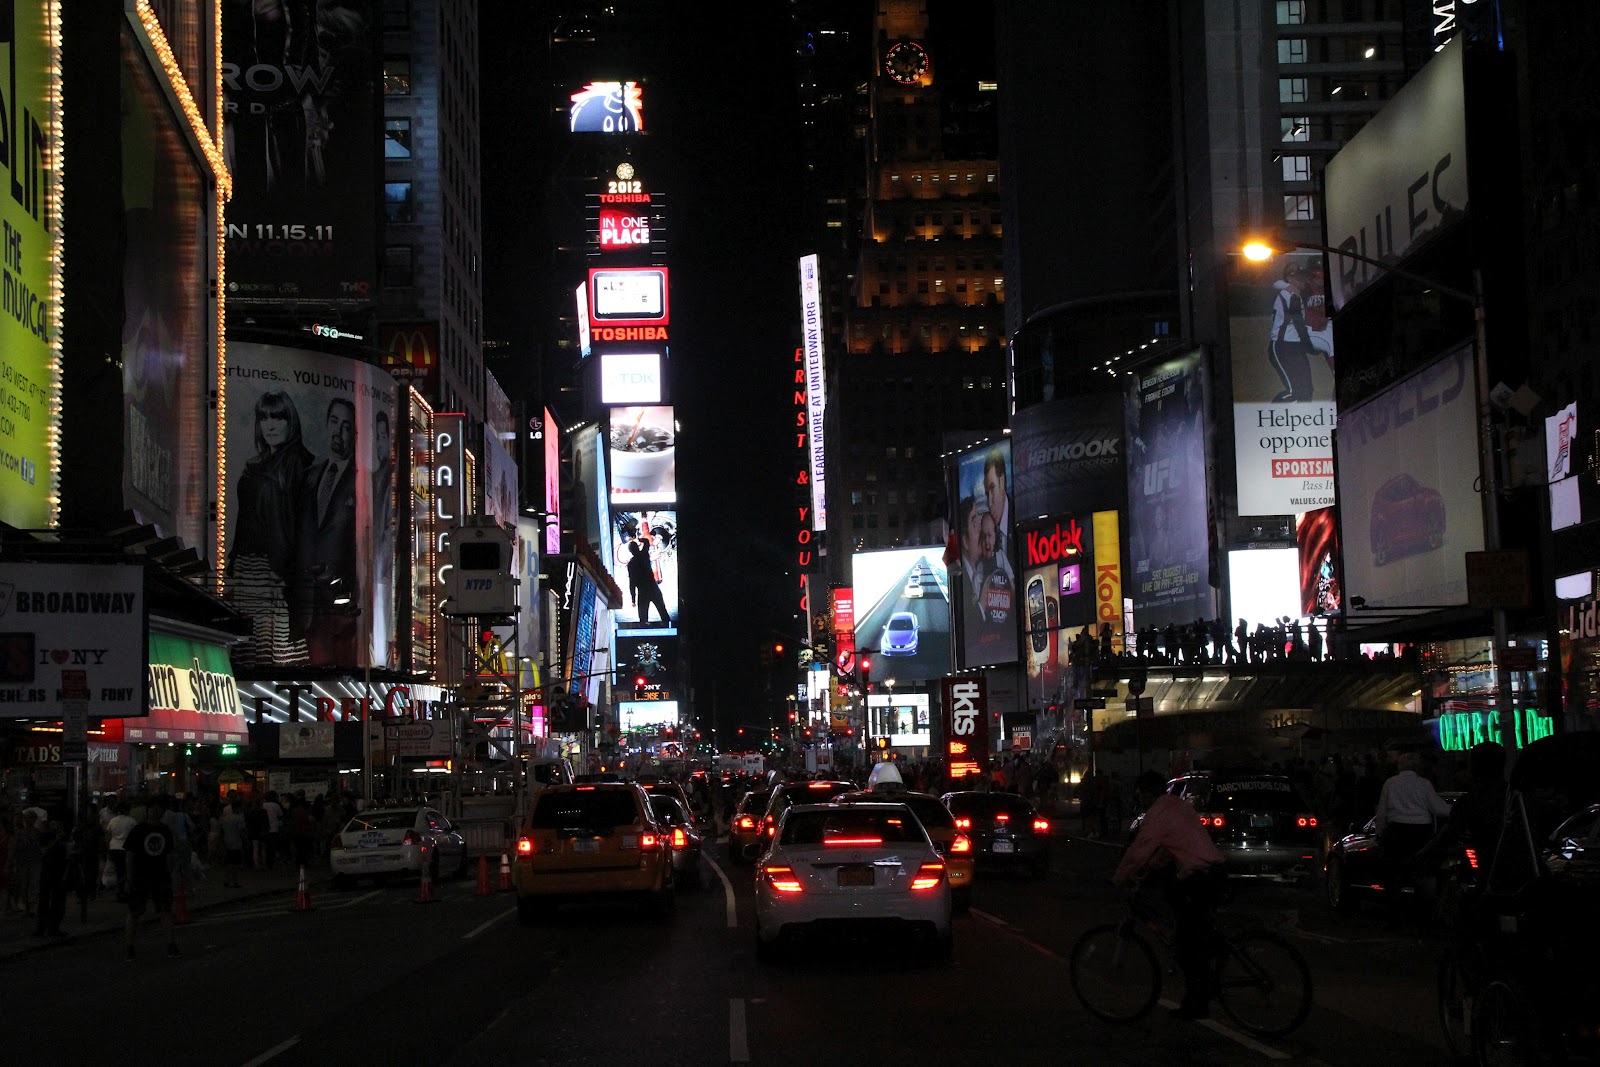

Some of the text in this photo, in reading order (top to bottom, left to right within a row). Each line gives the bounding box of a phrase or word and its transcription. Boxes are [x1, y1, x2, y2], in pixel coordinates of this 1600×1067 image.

[608, 181, 642, 194] 2012
[600, 194, 651, 203] TOSHIBA
[603, 217, 648, 228] IN ONE
[256, 225, 334, 240] 11.15.11
[602, 229, 650, 244] PLACE
[4, 219, 22, 276] THE
[4, 267, 49, 344] MUSICAL
[591, 327, 668, 341] TOSHIBA
[806, 301, 821, 391] UNITEDWAY.ORG
[294, 370, 320, 386] YOU
[324, 375, 355, 393] DON'T
[794, 347, 807, 448] ERNST
[810, 394, 822, 406] AT
[812, 411, 824, 443] MORE
[1257, 407, 1324, 432] Helped
[1259, 434, 1332, 453] oppone
[814, 446, 826, 482] LEARN
[796, 470, 809, 485] &
[1302, 480, 1323, 491] Pass
[1290, 497, 1336, 505] VALUES.COM
[1027, 517, 1084, 567] Kodak
[465, 578, 493, 591] NYPD
[16, 591, 136, 614] BROADWAY
[71, 649, 108, 665] NY
[188, 657, 238, 717] sbarro
[953, 681, 980, 736] tkts
